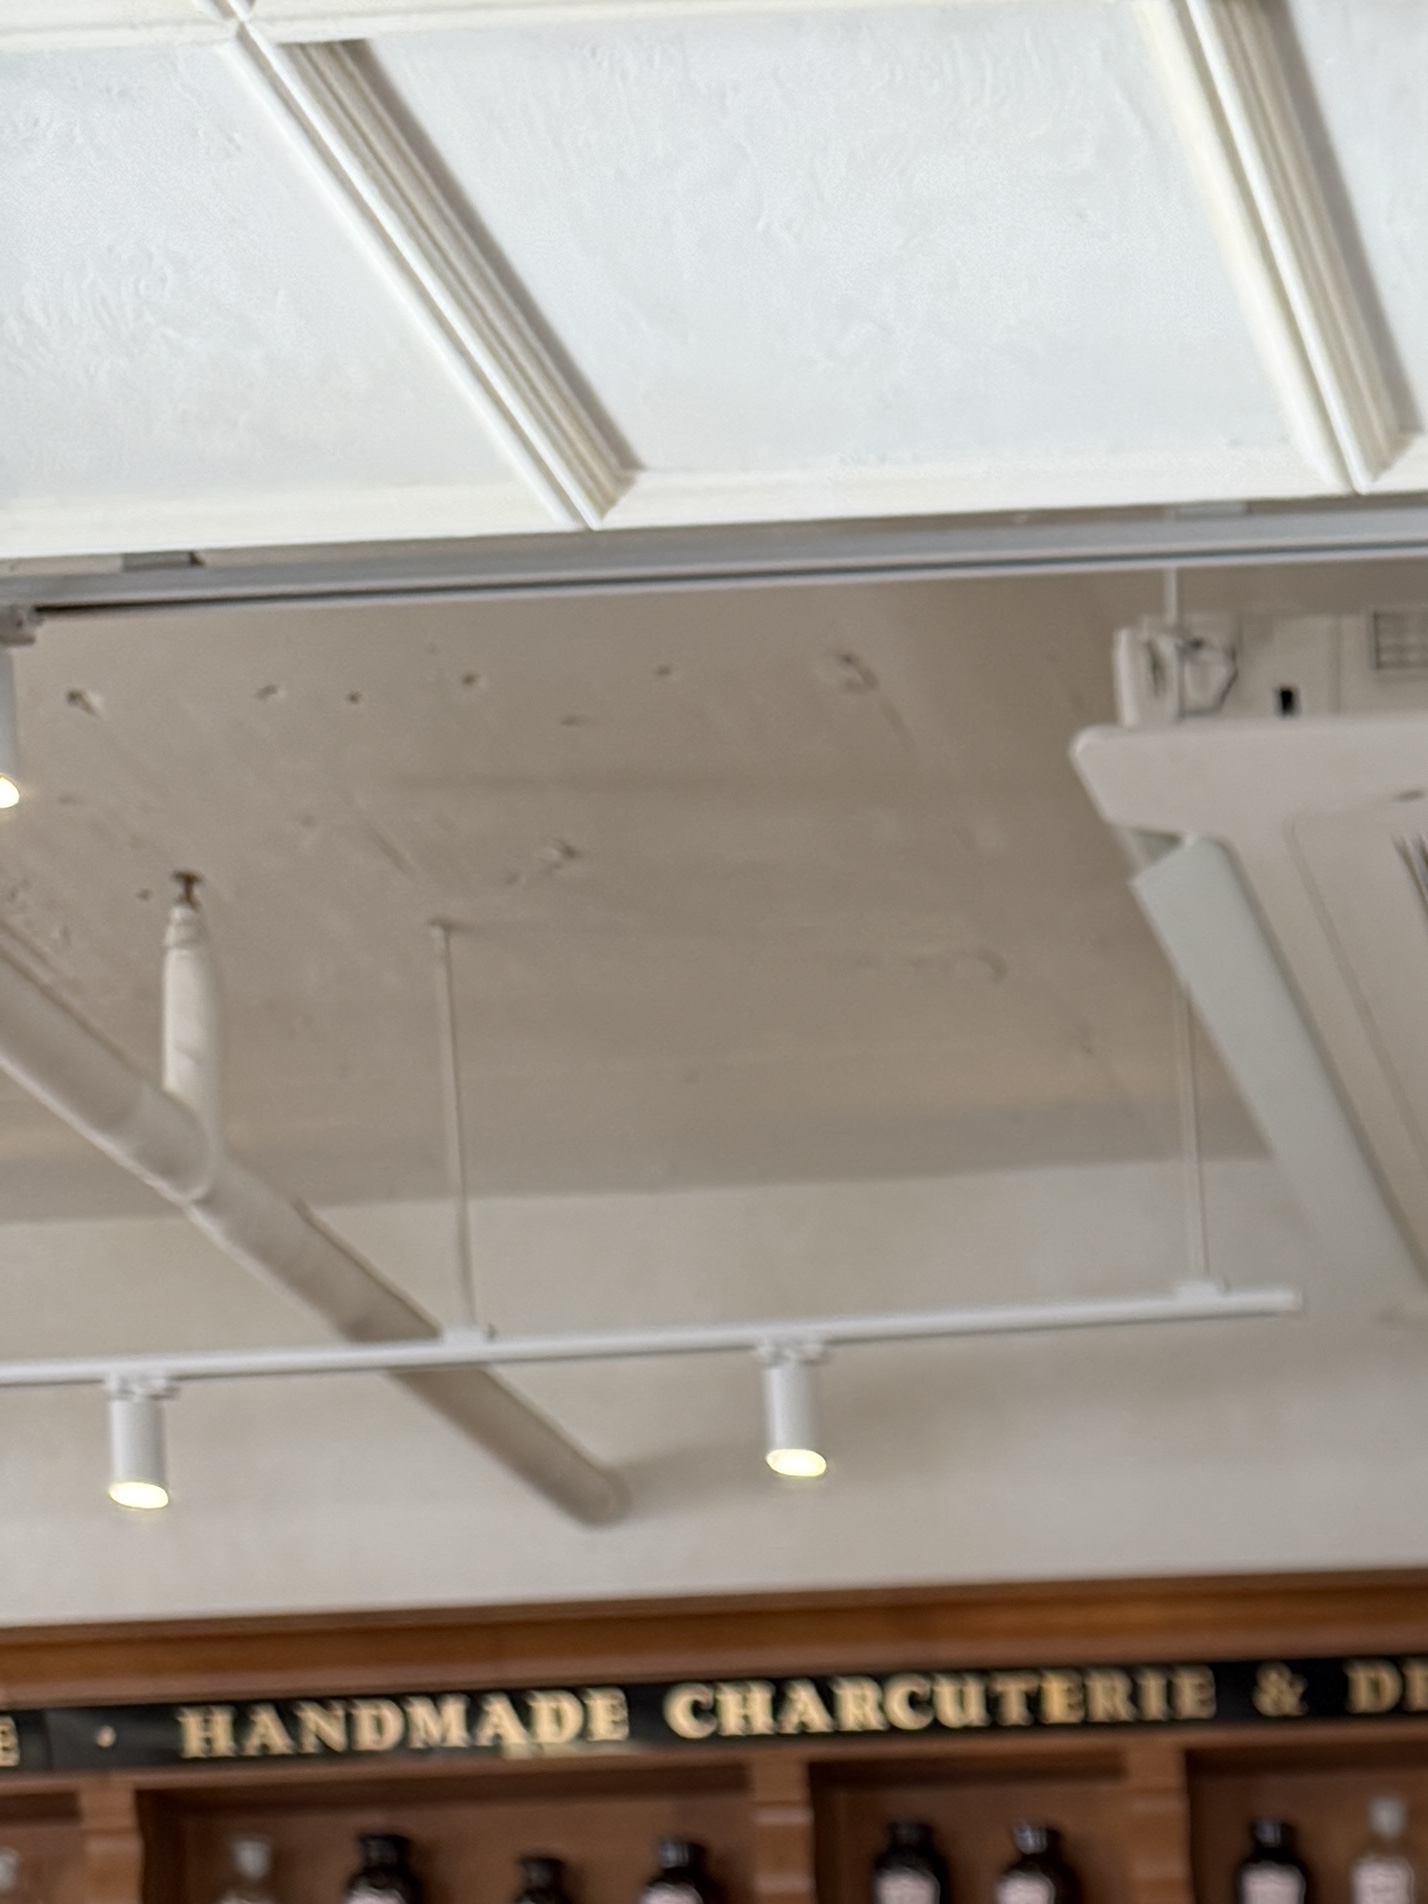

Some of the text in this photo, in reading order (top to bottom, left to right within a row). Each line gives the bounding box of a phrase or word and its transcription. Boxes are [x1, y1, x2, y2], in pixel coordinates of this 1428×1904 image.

[174, 1685, 631, 1760] HANDMADE
[663, 1665, 1217, 1740] CHARCUTERIE
[1252, 1661, 1307, 1717] &
